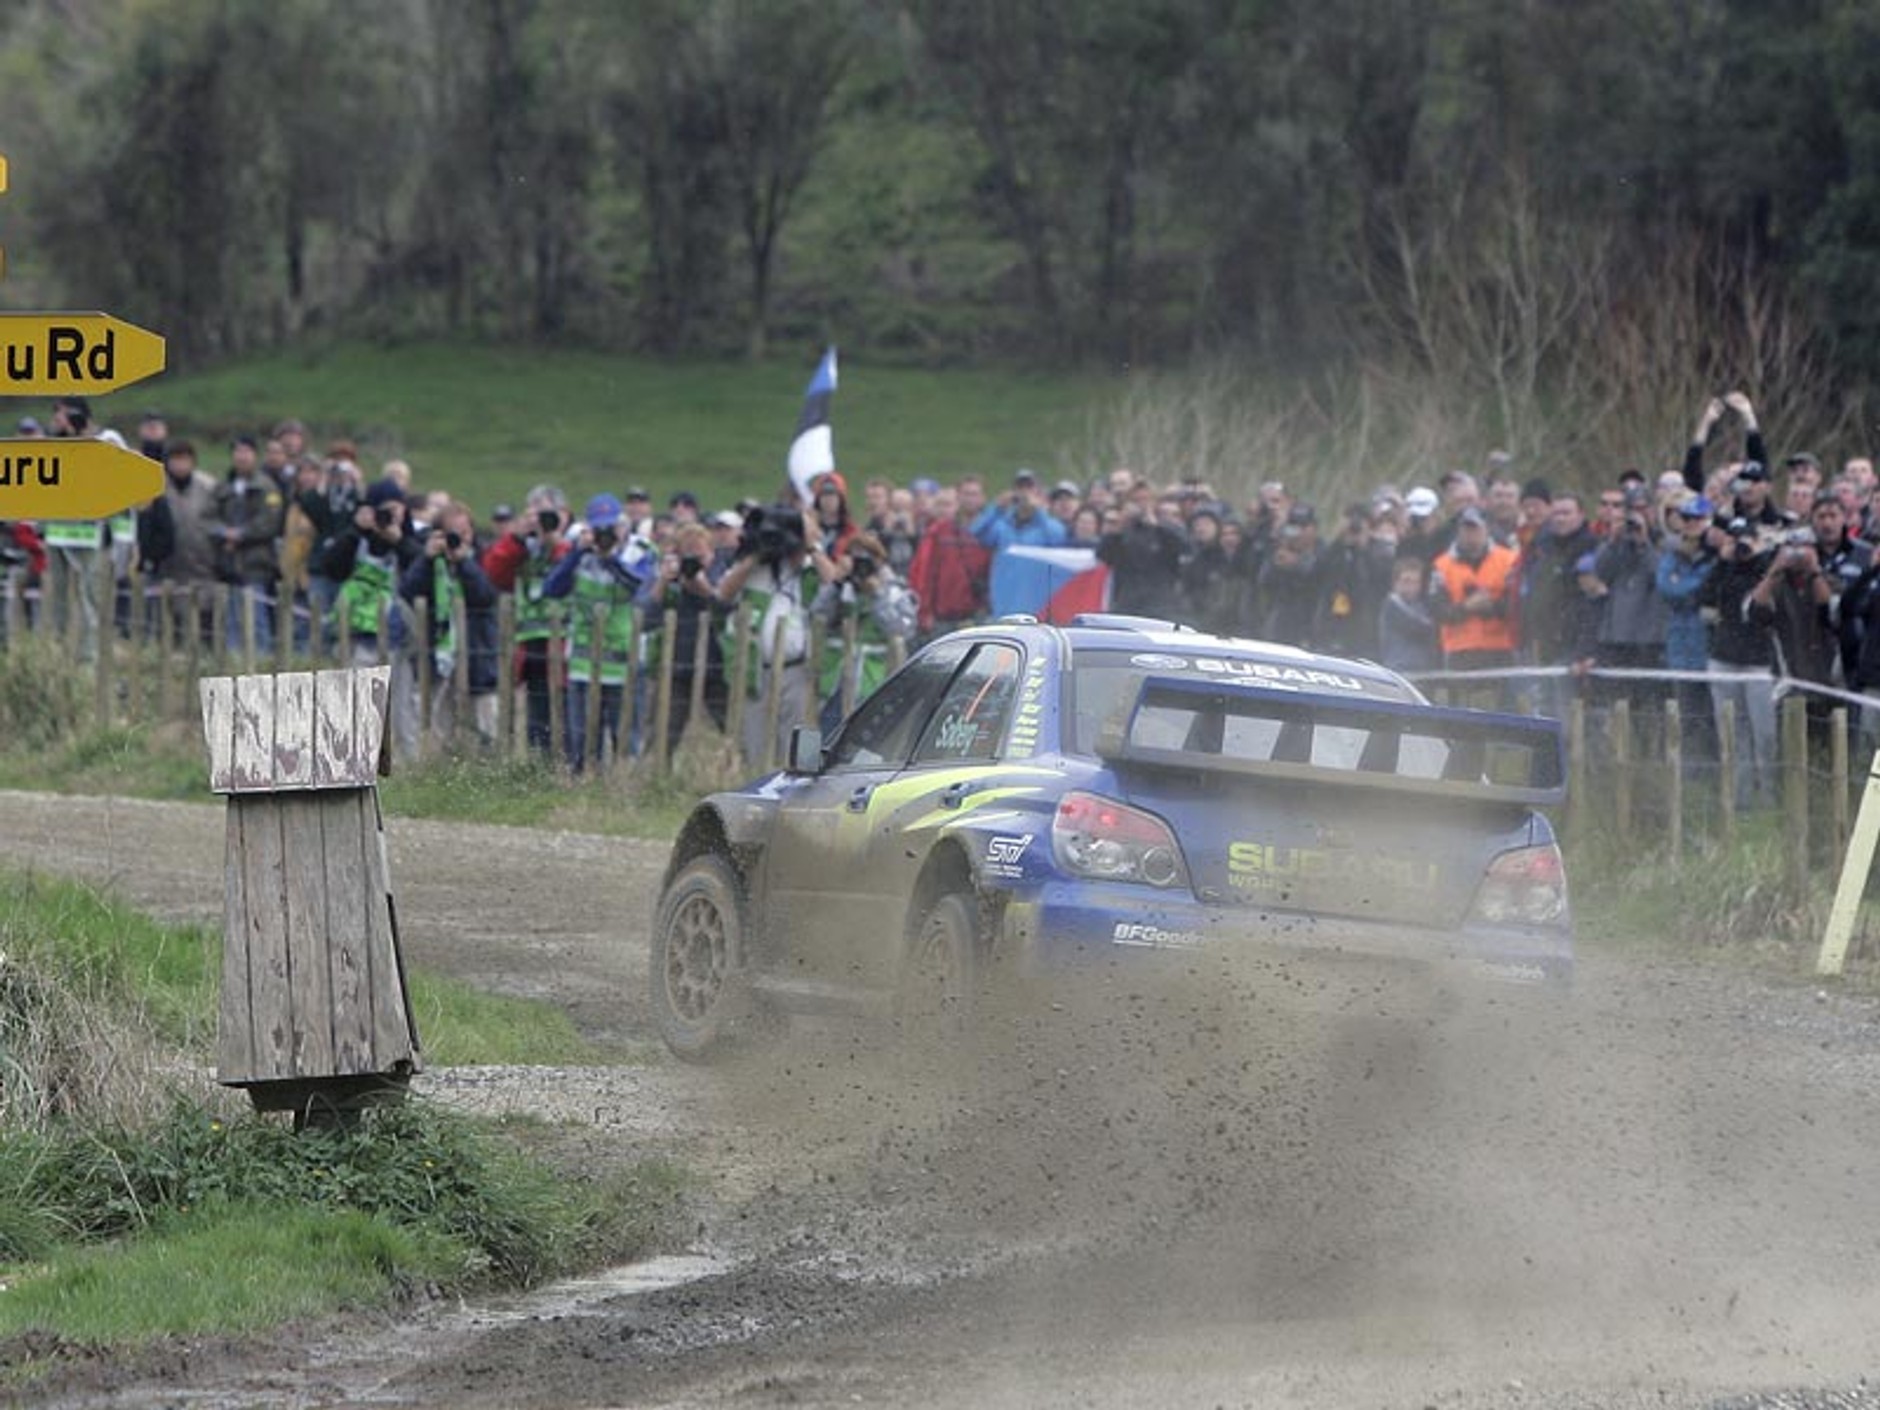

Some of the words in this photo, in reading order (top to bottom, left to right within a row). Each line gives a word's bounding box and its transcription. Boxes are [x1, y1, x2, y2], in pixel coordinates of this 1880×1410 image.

[48, 327, 114, 380] Rd
[1195, 659, 1362, 690] SUBARU
[1228, 840, 1439, 885] SUBU
